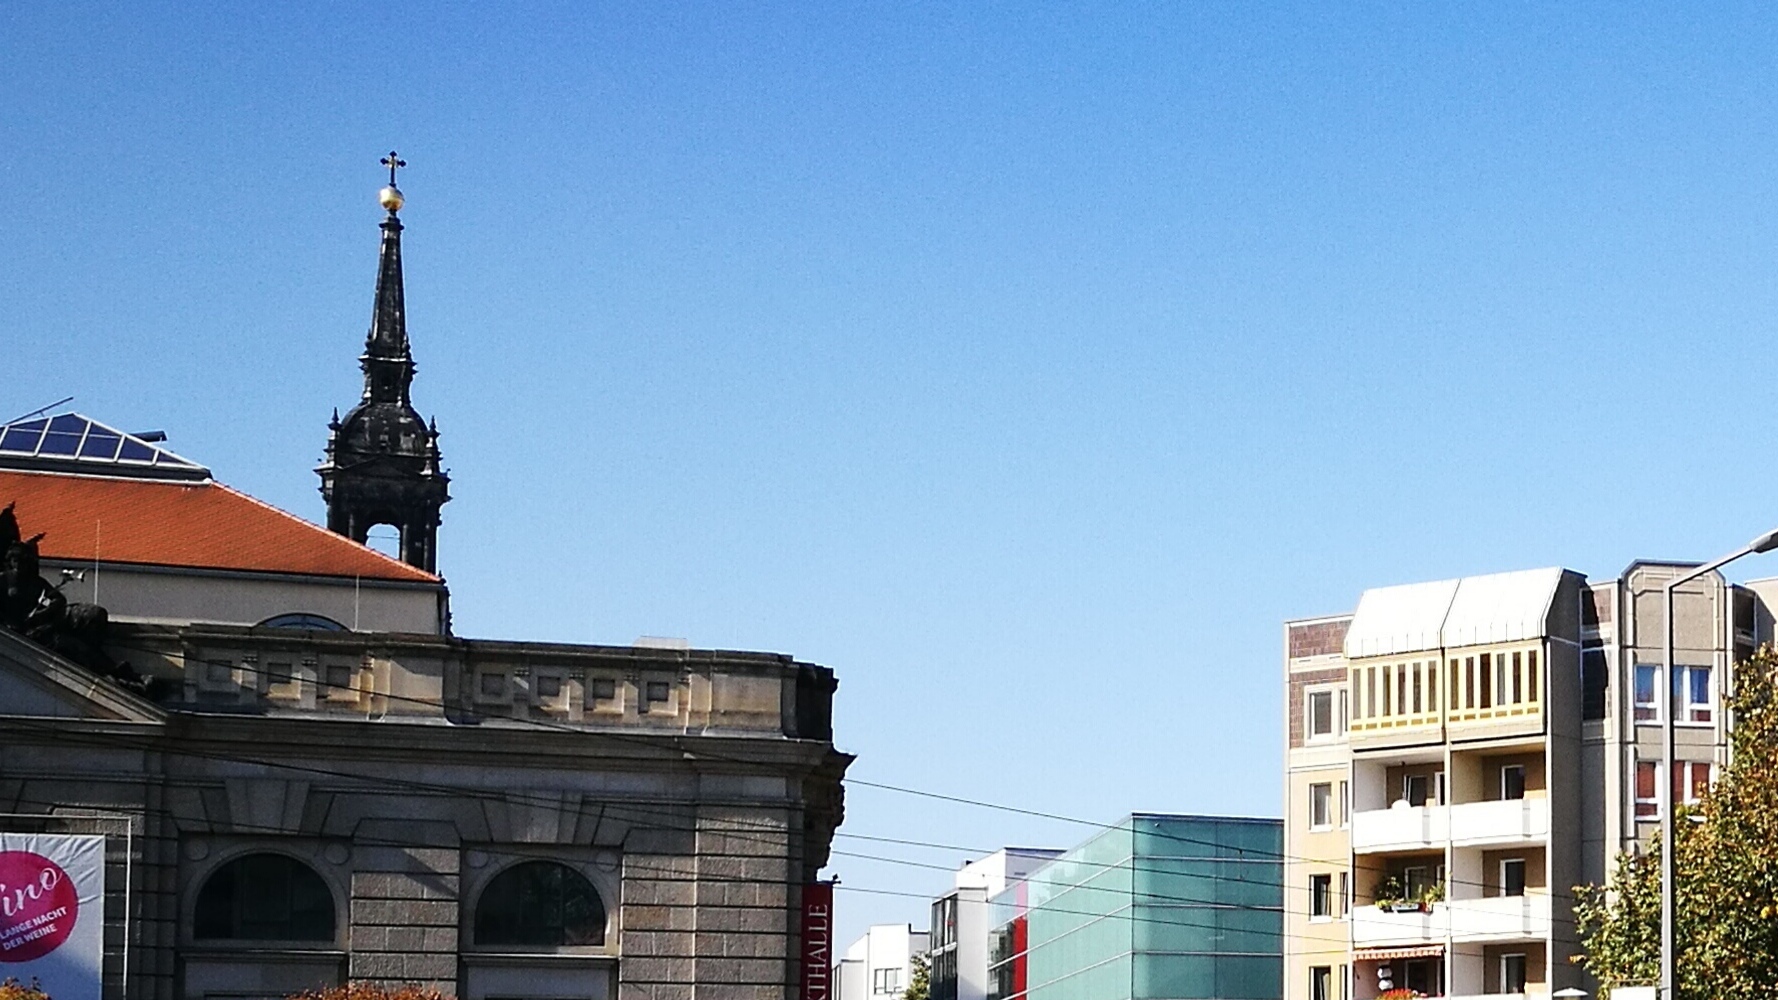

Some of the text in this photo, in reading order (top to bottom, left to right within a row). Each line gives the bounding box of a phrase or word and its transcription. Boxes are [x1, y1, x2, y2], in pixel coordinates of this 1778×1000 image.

[0, 867, 62, 916] ino
[0, 906, 67, 940] LANGE NACHT
[3, 923, 58, 951] DER WEINE
